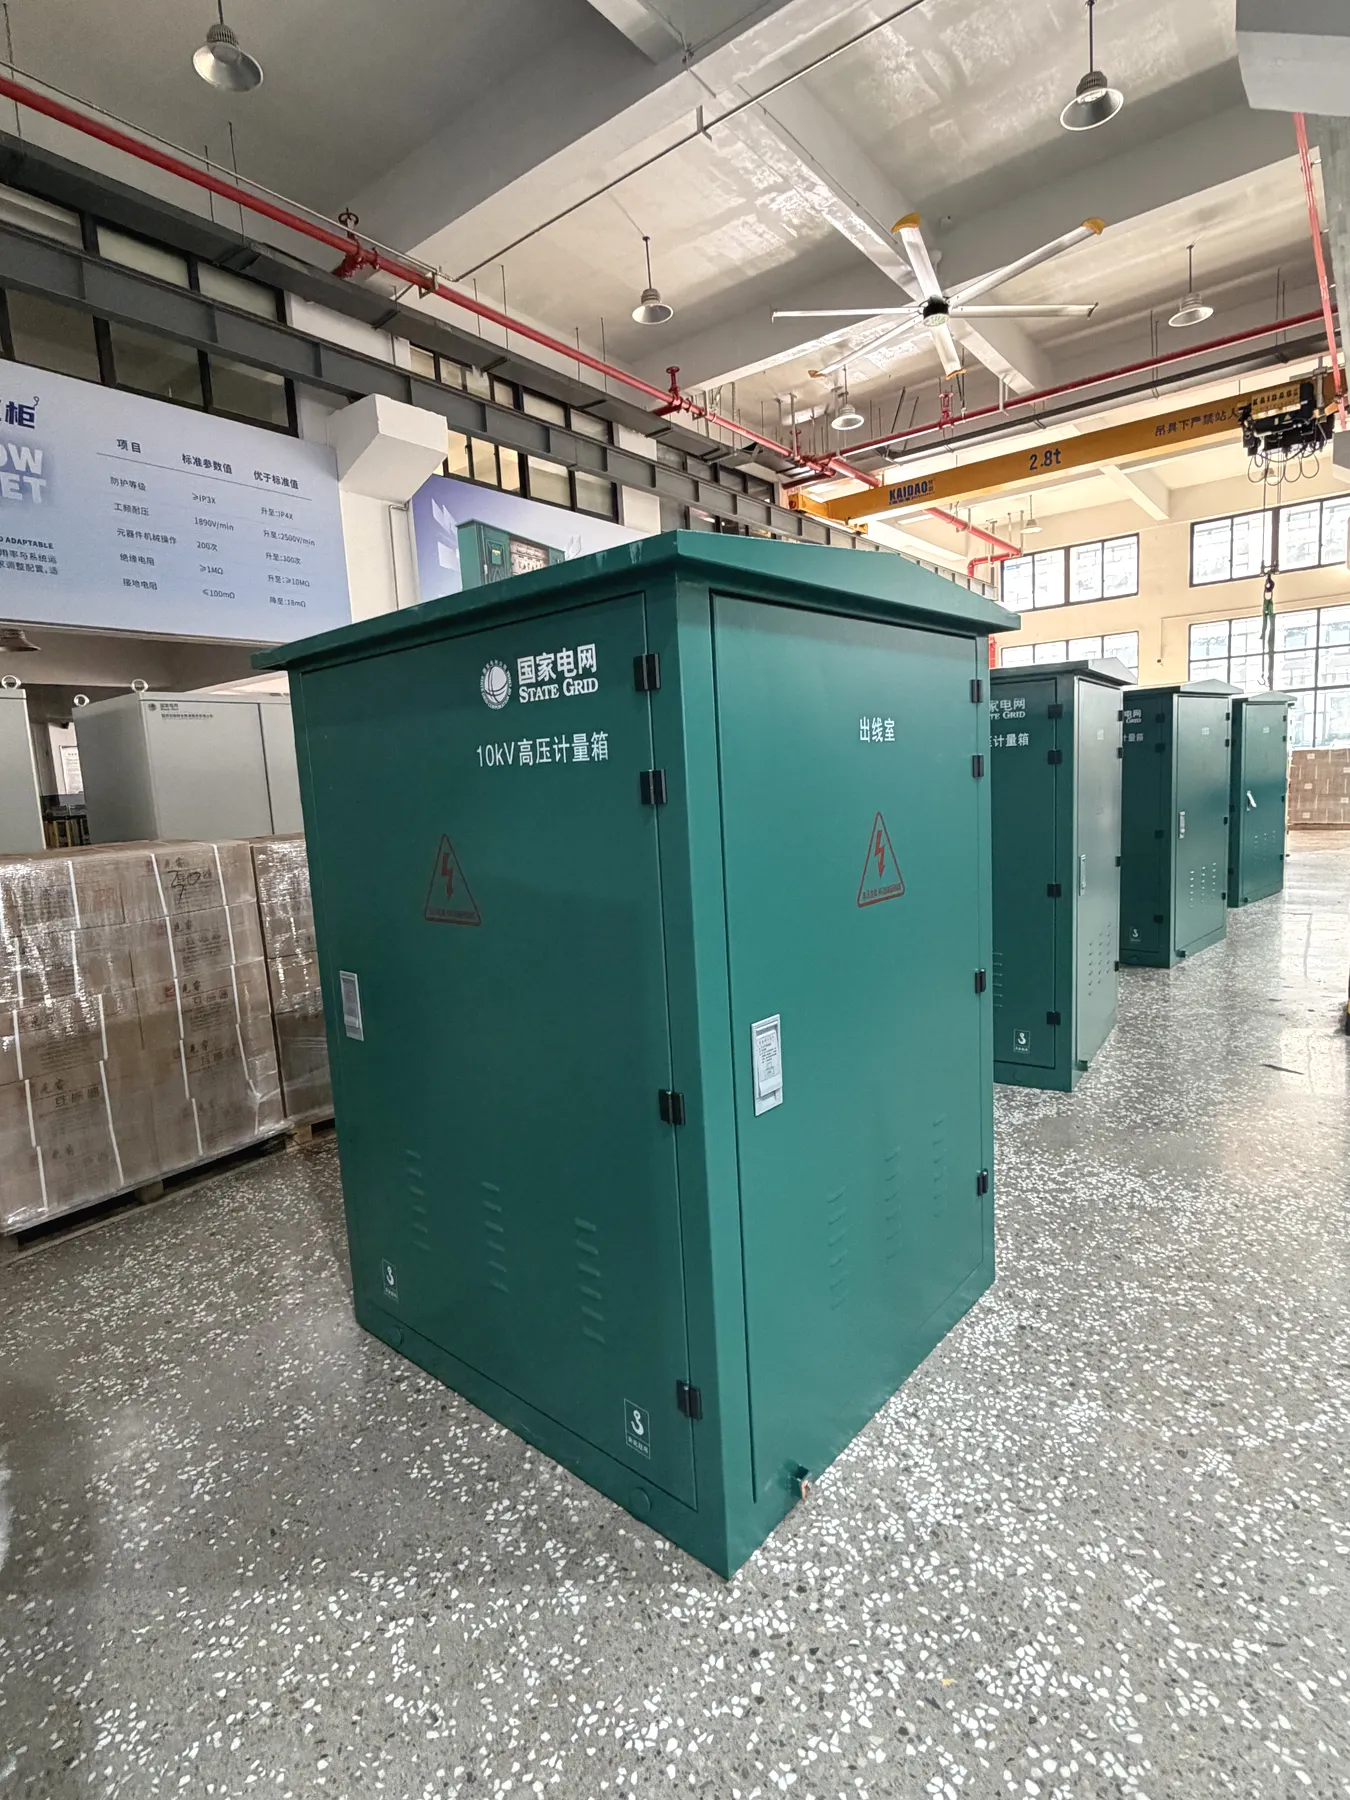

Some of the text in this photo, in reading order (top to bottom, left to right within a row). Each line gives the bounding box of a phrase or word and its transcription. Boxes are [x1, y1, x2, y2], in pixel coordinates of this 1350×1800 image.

[0, 400, 36, 429] 柜
[116, 438, 142, 454] 项目
[181, 453, 233, 475] 标准参数值
[1030, 448, 1062, 471] 2.8t
[253, 470, 299, 490] 优于标准值
[889, 480, 928, 501] KAIDAO
[113, 502, 150, 516] 工频耐压
[194, 517, 235, 531] 1890V/min
[5, 537, 54, 549] ADAPTABLE
[517, 643, 598, 685] 国家电网
[519, 677, 599, 704] STATE GRID
[859, 716, 896, 743] 出线室
[989, 732, 1029, 748] 计量箱
